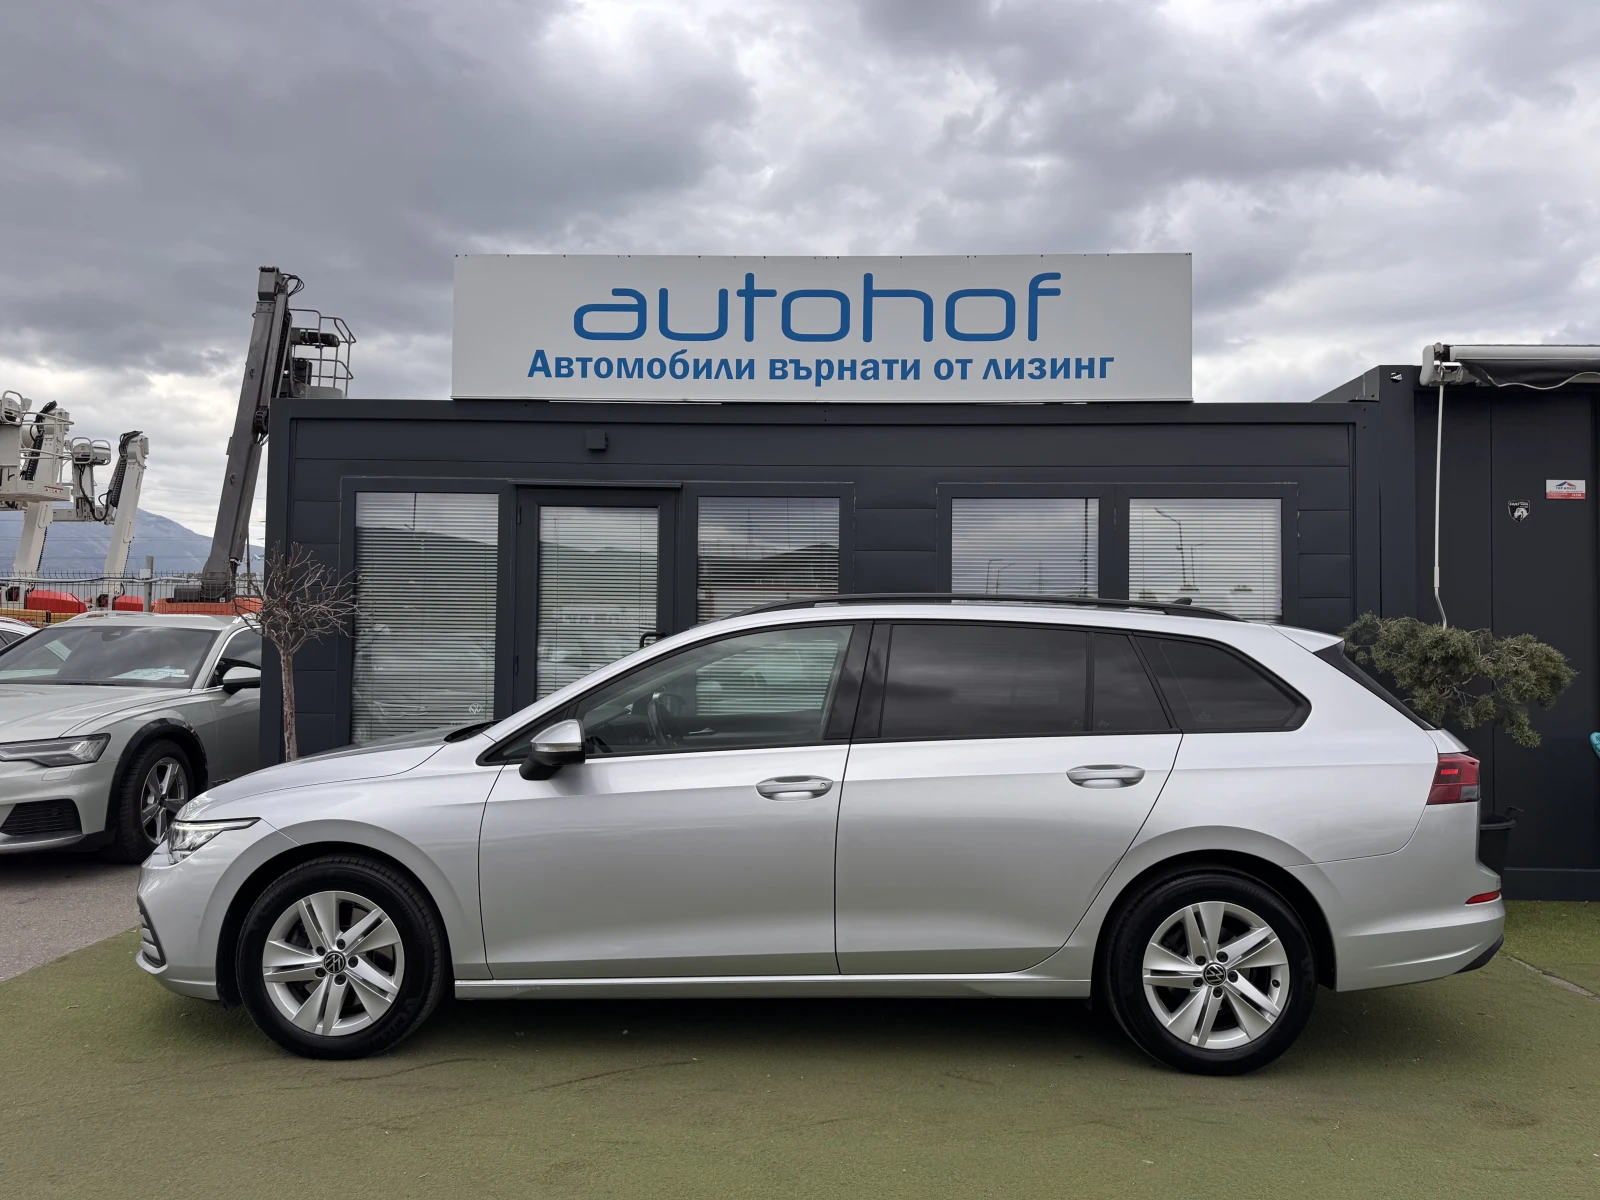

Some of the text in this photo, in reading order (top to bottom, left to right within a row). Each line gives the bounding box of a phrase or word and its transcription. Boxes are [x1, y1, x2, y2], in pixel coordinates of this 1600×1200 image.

[573, 271, 1062, 343] autohof
[527, 349, 1115, 388] Автомобили върнати от лизинг
